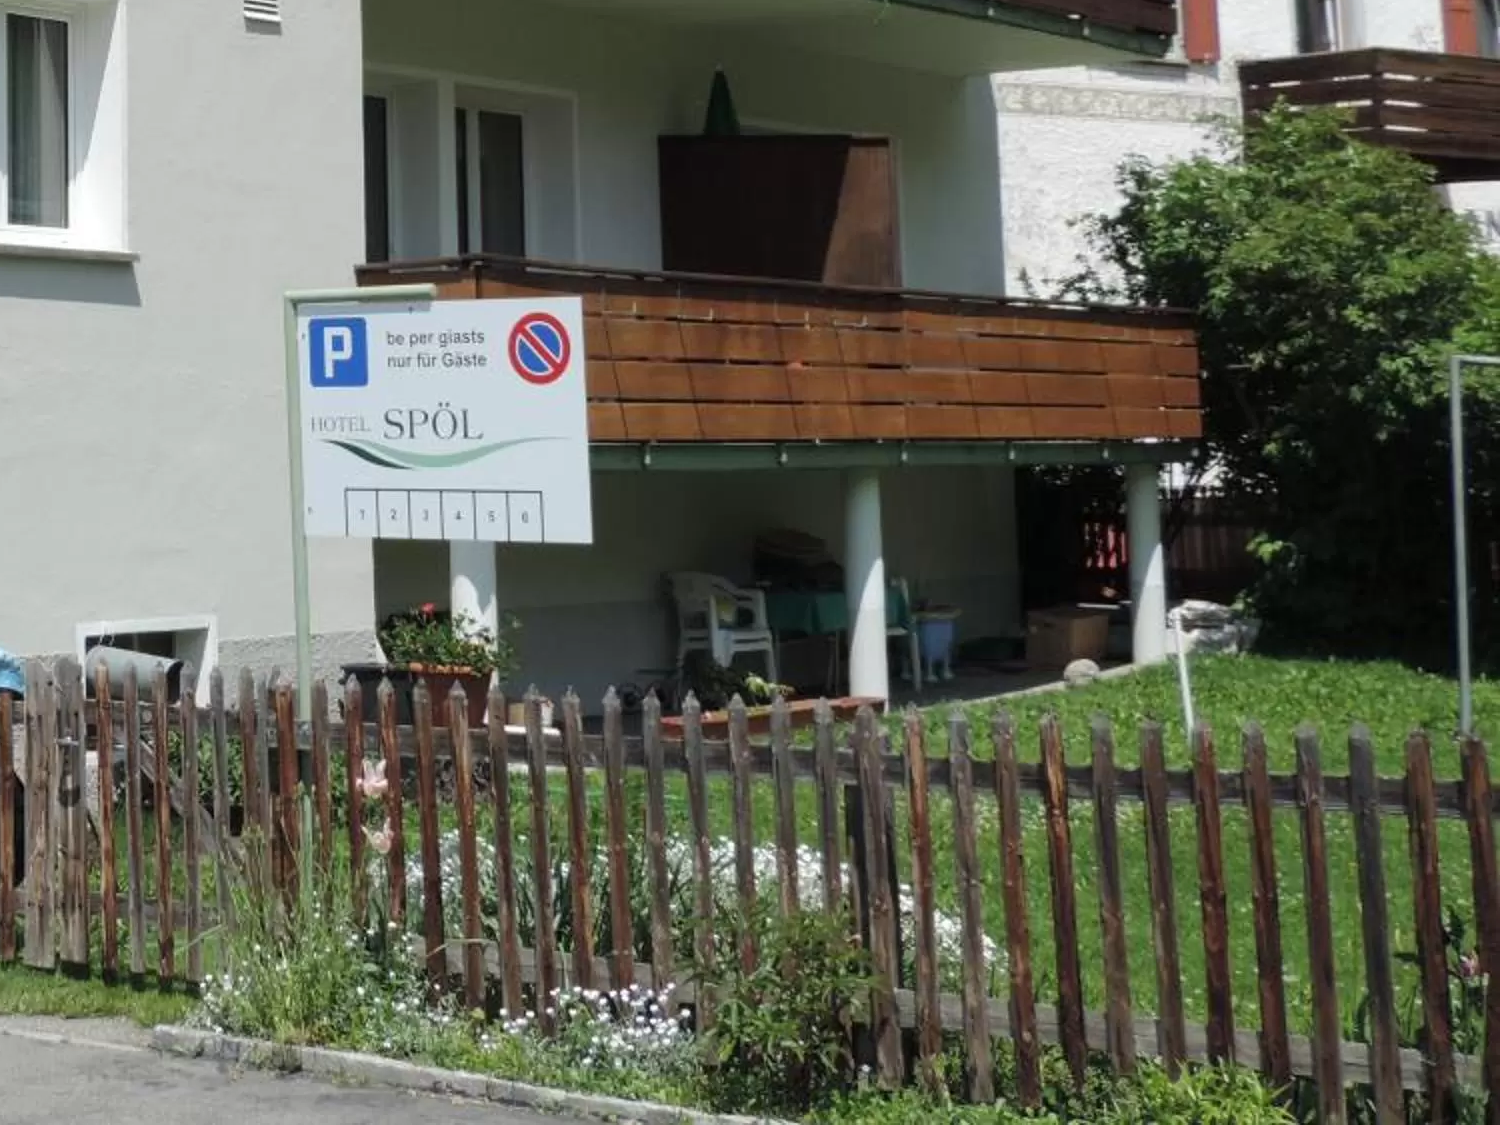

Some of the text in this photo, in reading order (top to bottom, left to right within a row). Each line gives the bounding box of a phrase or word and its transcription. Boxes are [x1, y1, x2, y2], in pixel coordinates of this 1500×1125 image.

[323, 326, 353, 379] P
[385, 330, 405, 346] be
[408, 332, 434, 348] per
[386, 351, 488, 369] nur für Gäste
[311, 401, 485, 440] HOTEL SPÖL
